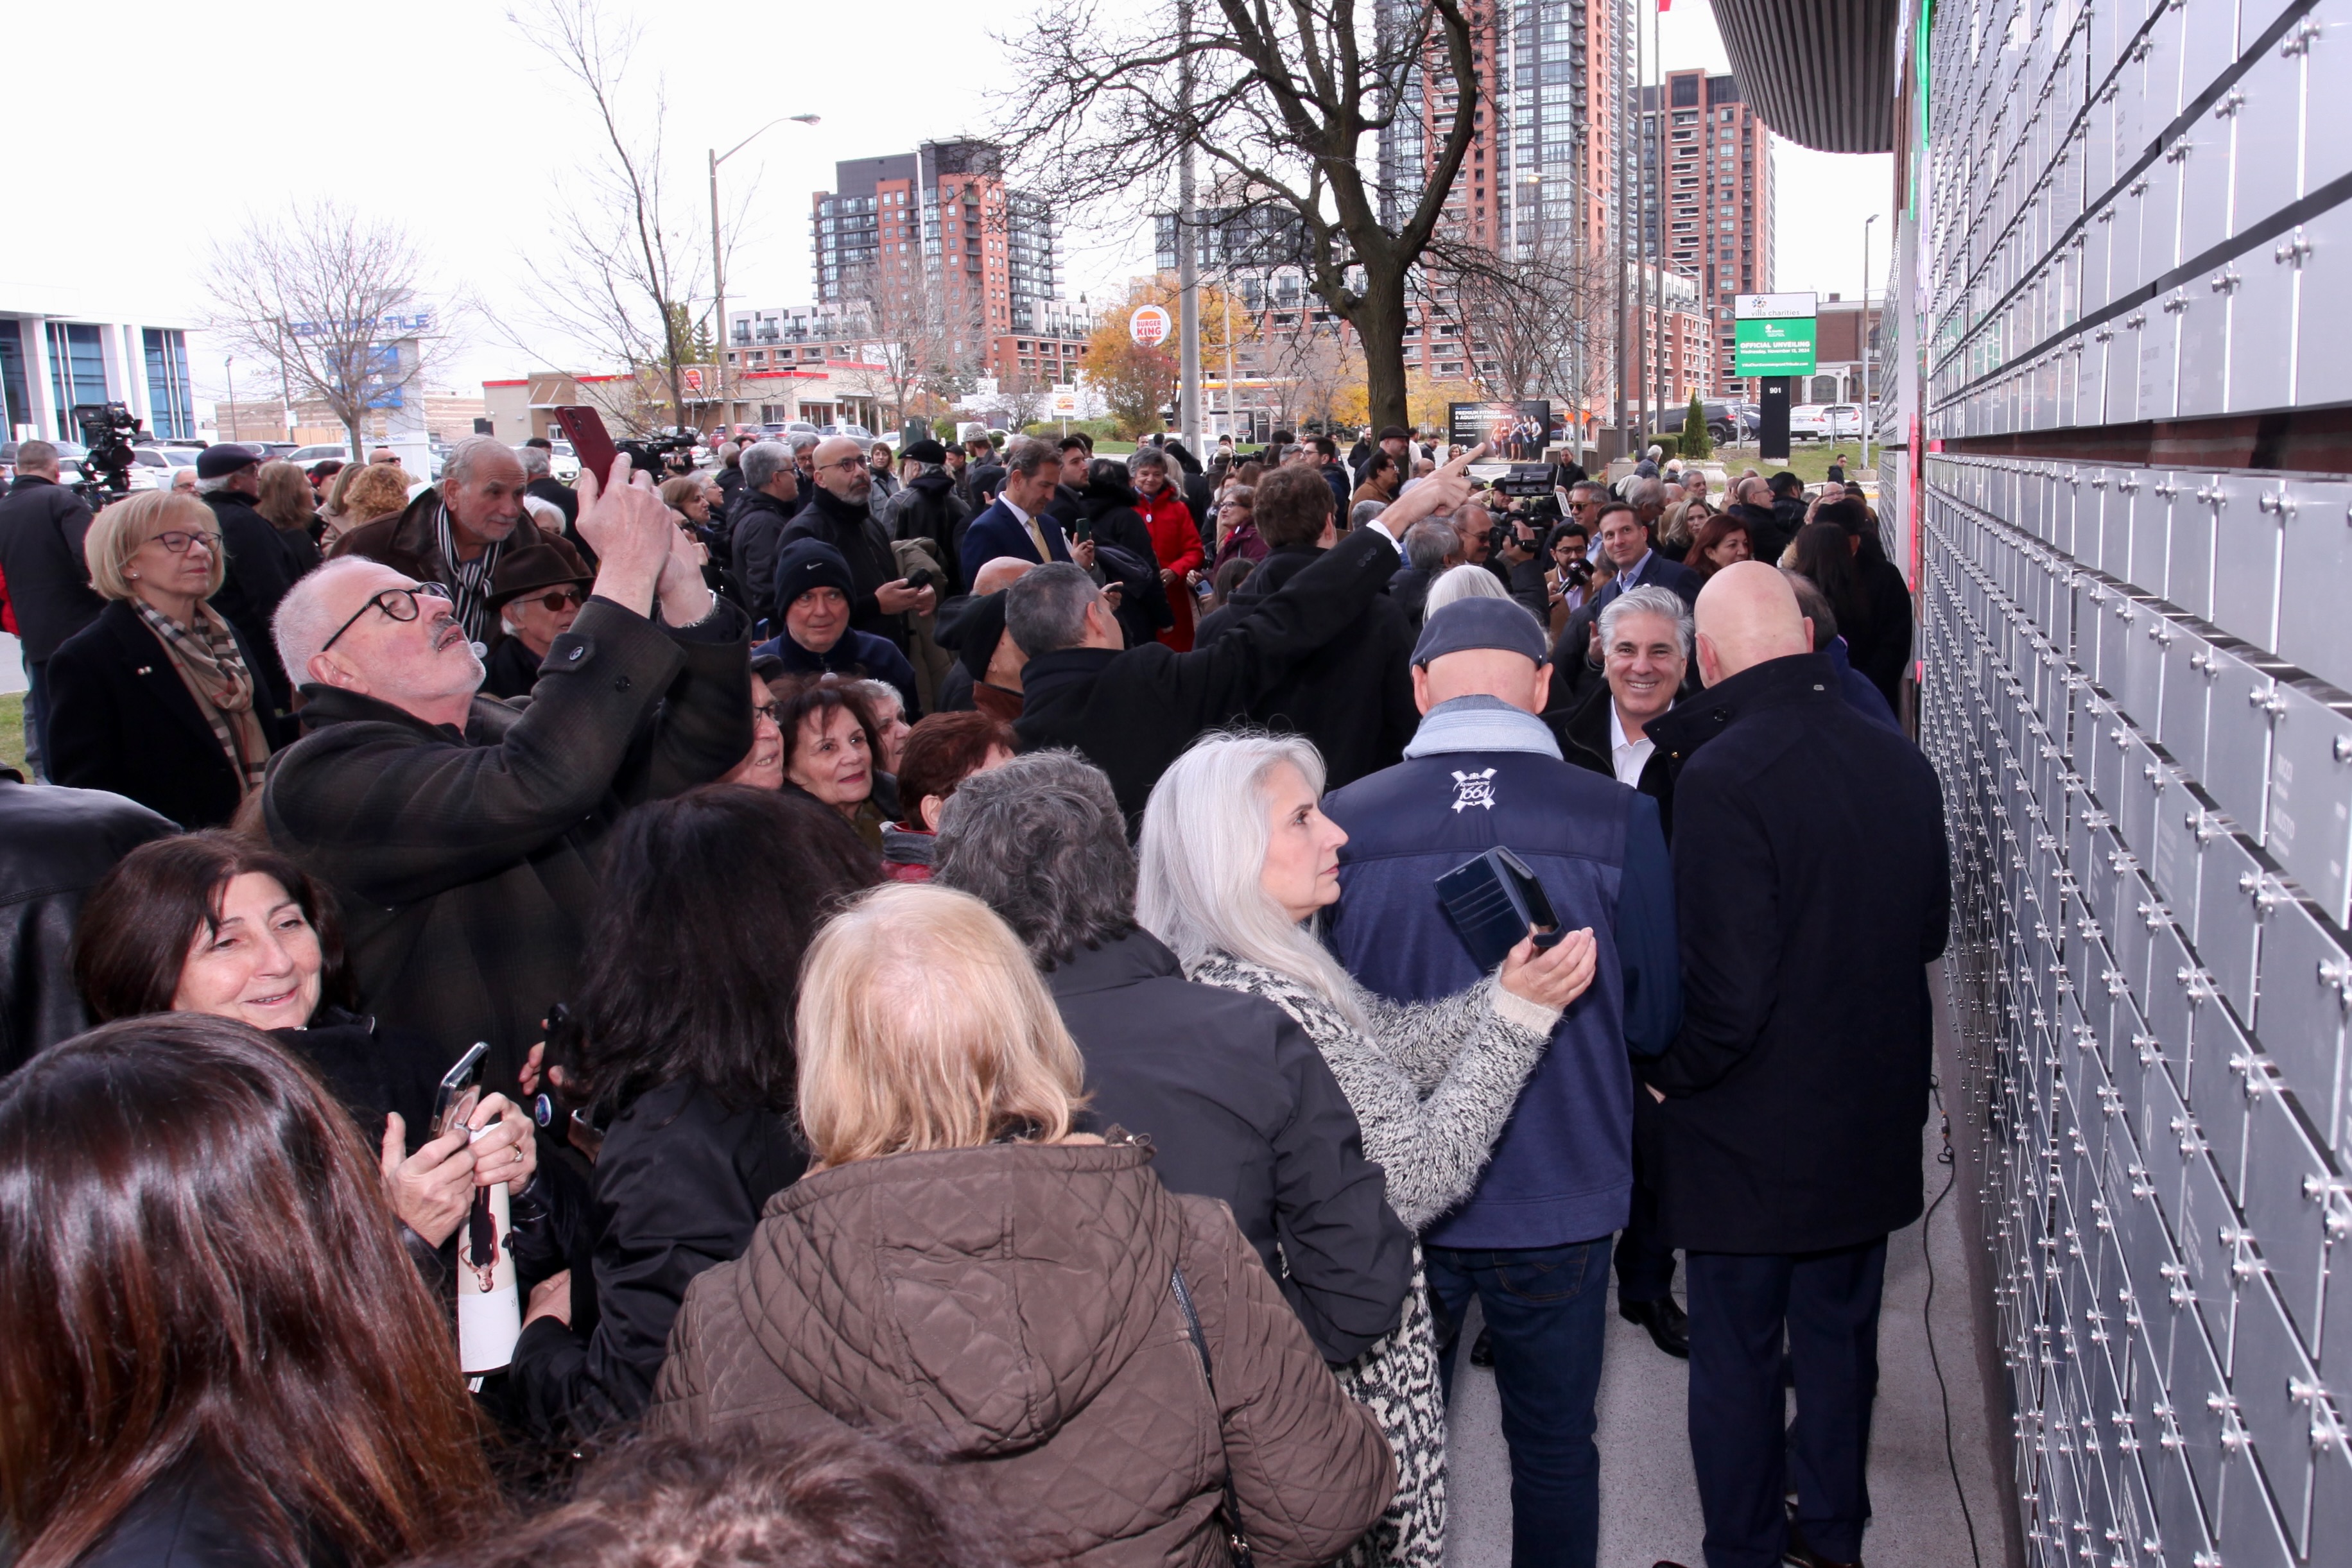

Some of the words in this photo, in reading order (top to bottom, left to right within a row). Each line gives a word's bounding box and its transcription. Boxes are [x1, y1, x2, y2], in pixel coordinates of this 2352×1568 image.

[384, 314, 429, 330] TILE
[1137, 327, 1161, 336] KING
[1459, 785, 1490, 800] 1664
